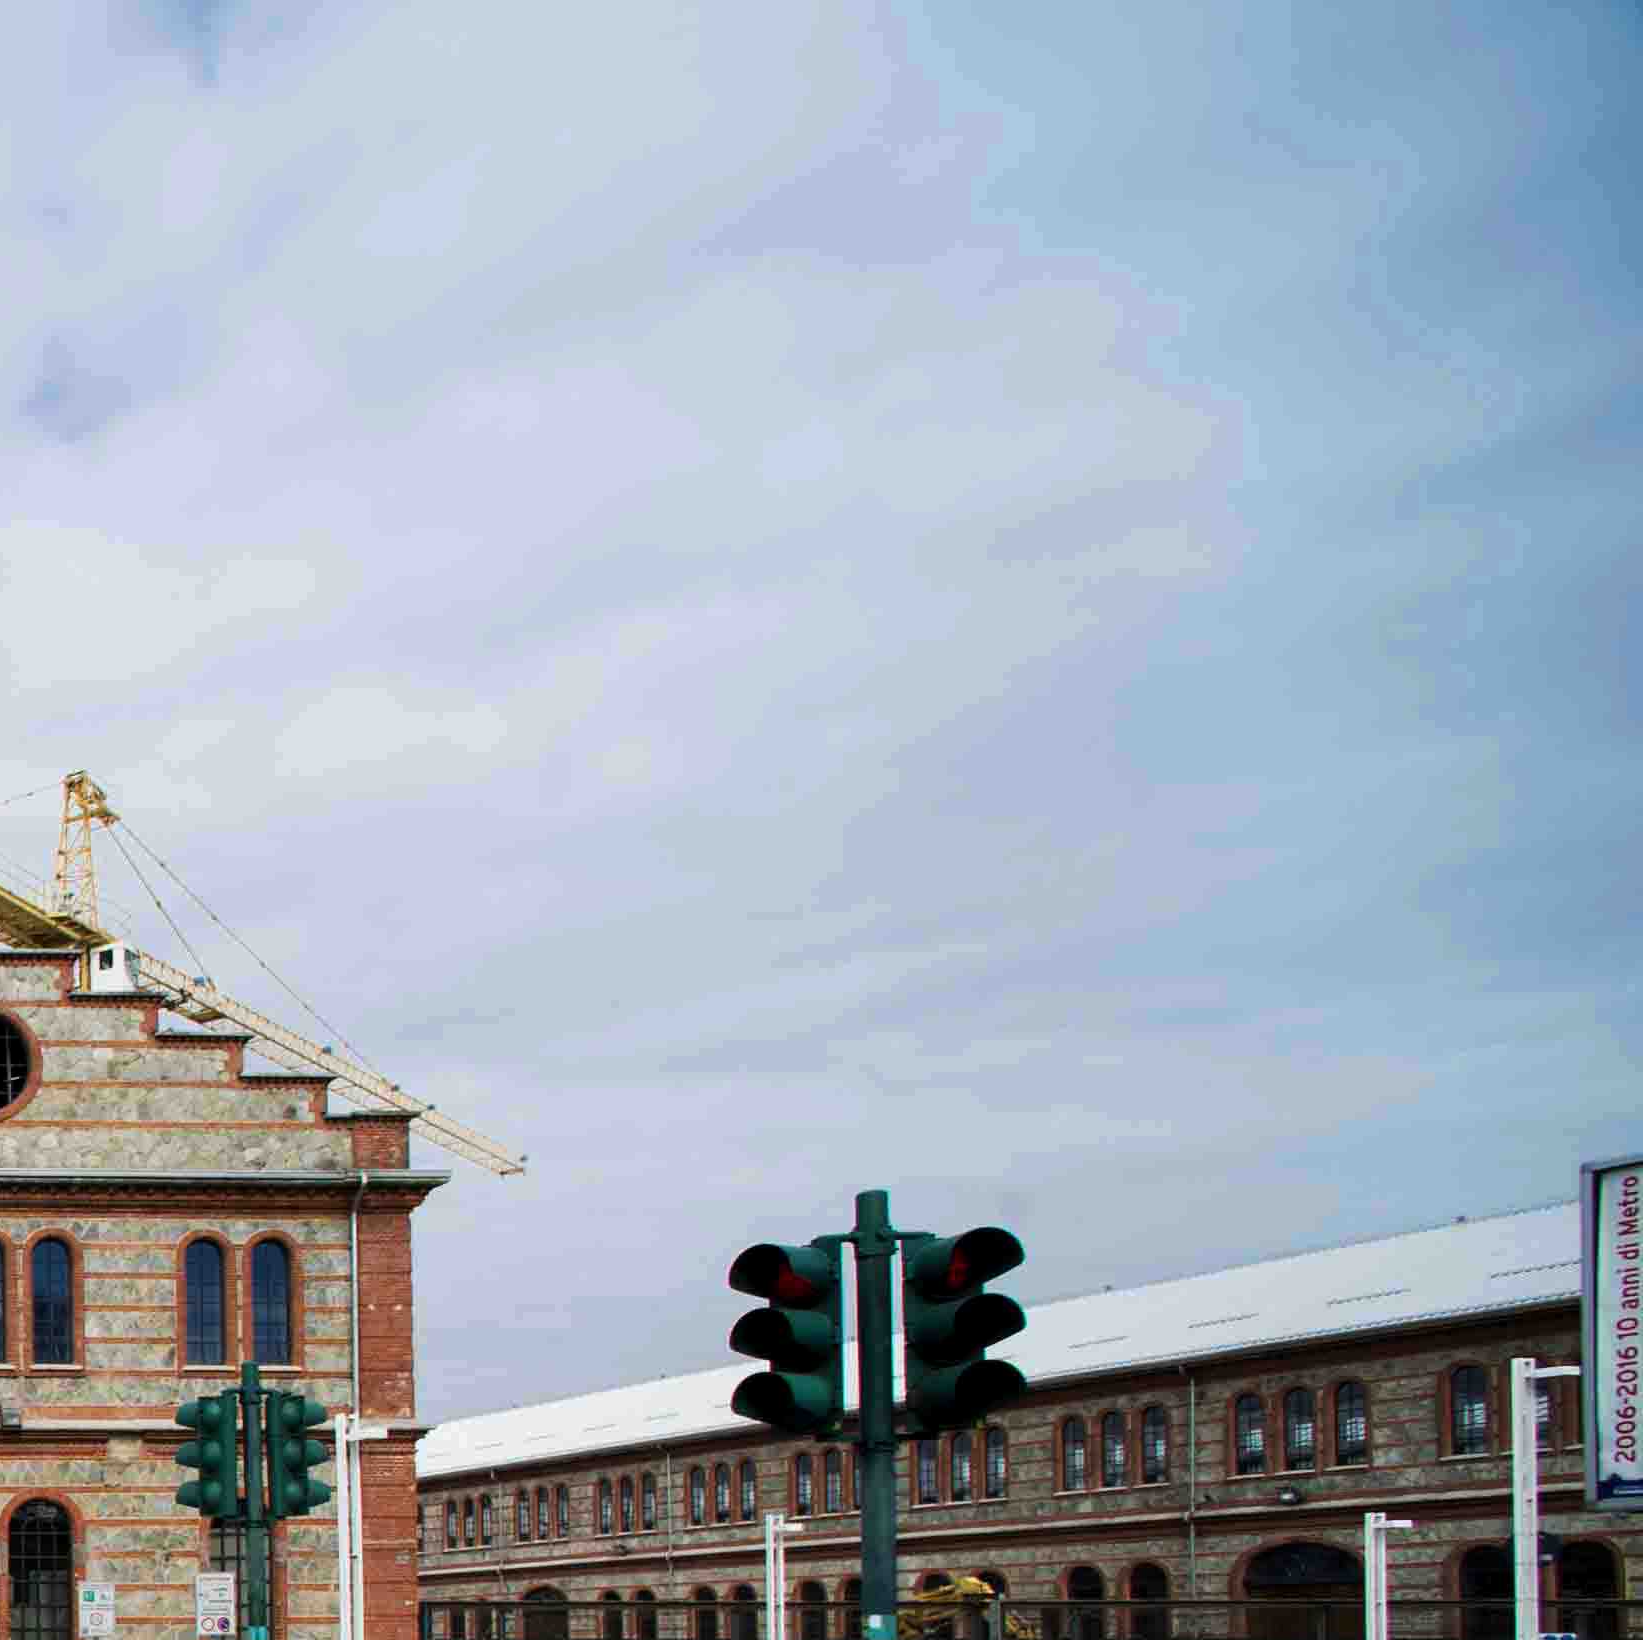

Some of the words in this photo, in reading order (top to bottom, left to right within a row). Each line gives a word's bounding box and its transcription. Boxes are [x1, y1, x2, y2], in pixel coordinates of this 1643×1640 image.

[1618, 1176, 1640, 1236] Metro
[1617, 1242, 1640, 1259] di
[1617, 1268, 1639, 1310] anni
[1617, 1317, 1638, 1340] 10
[1615, 1346, 1637, 1463] 2006-2016
